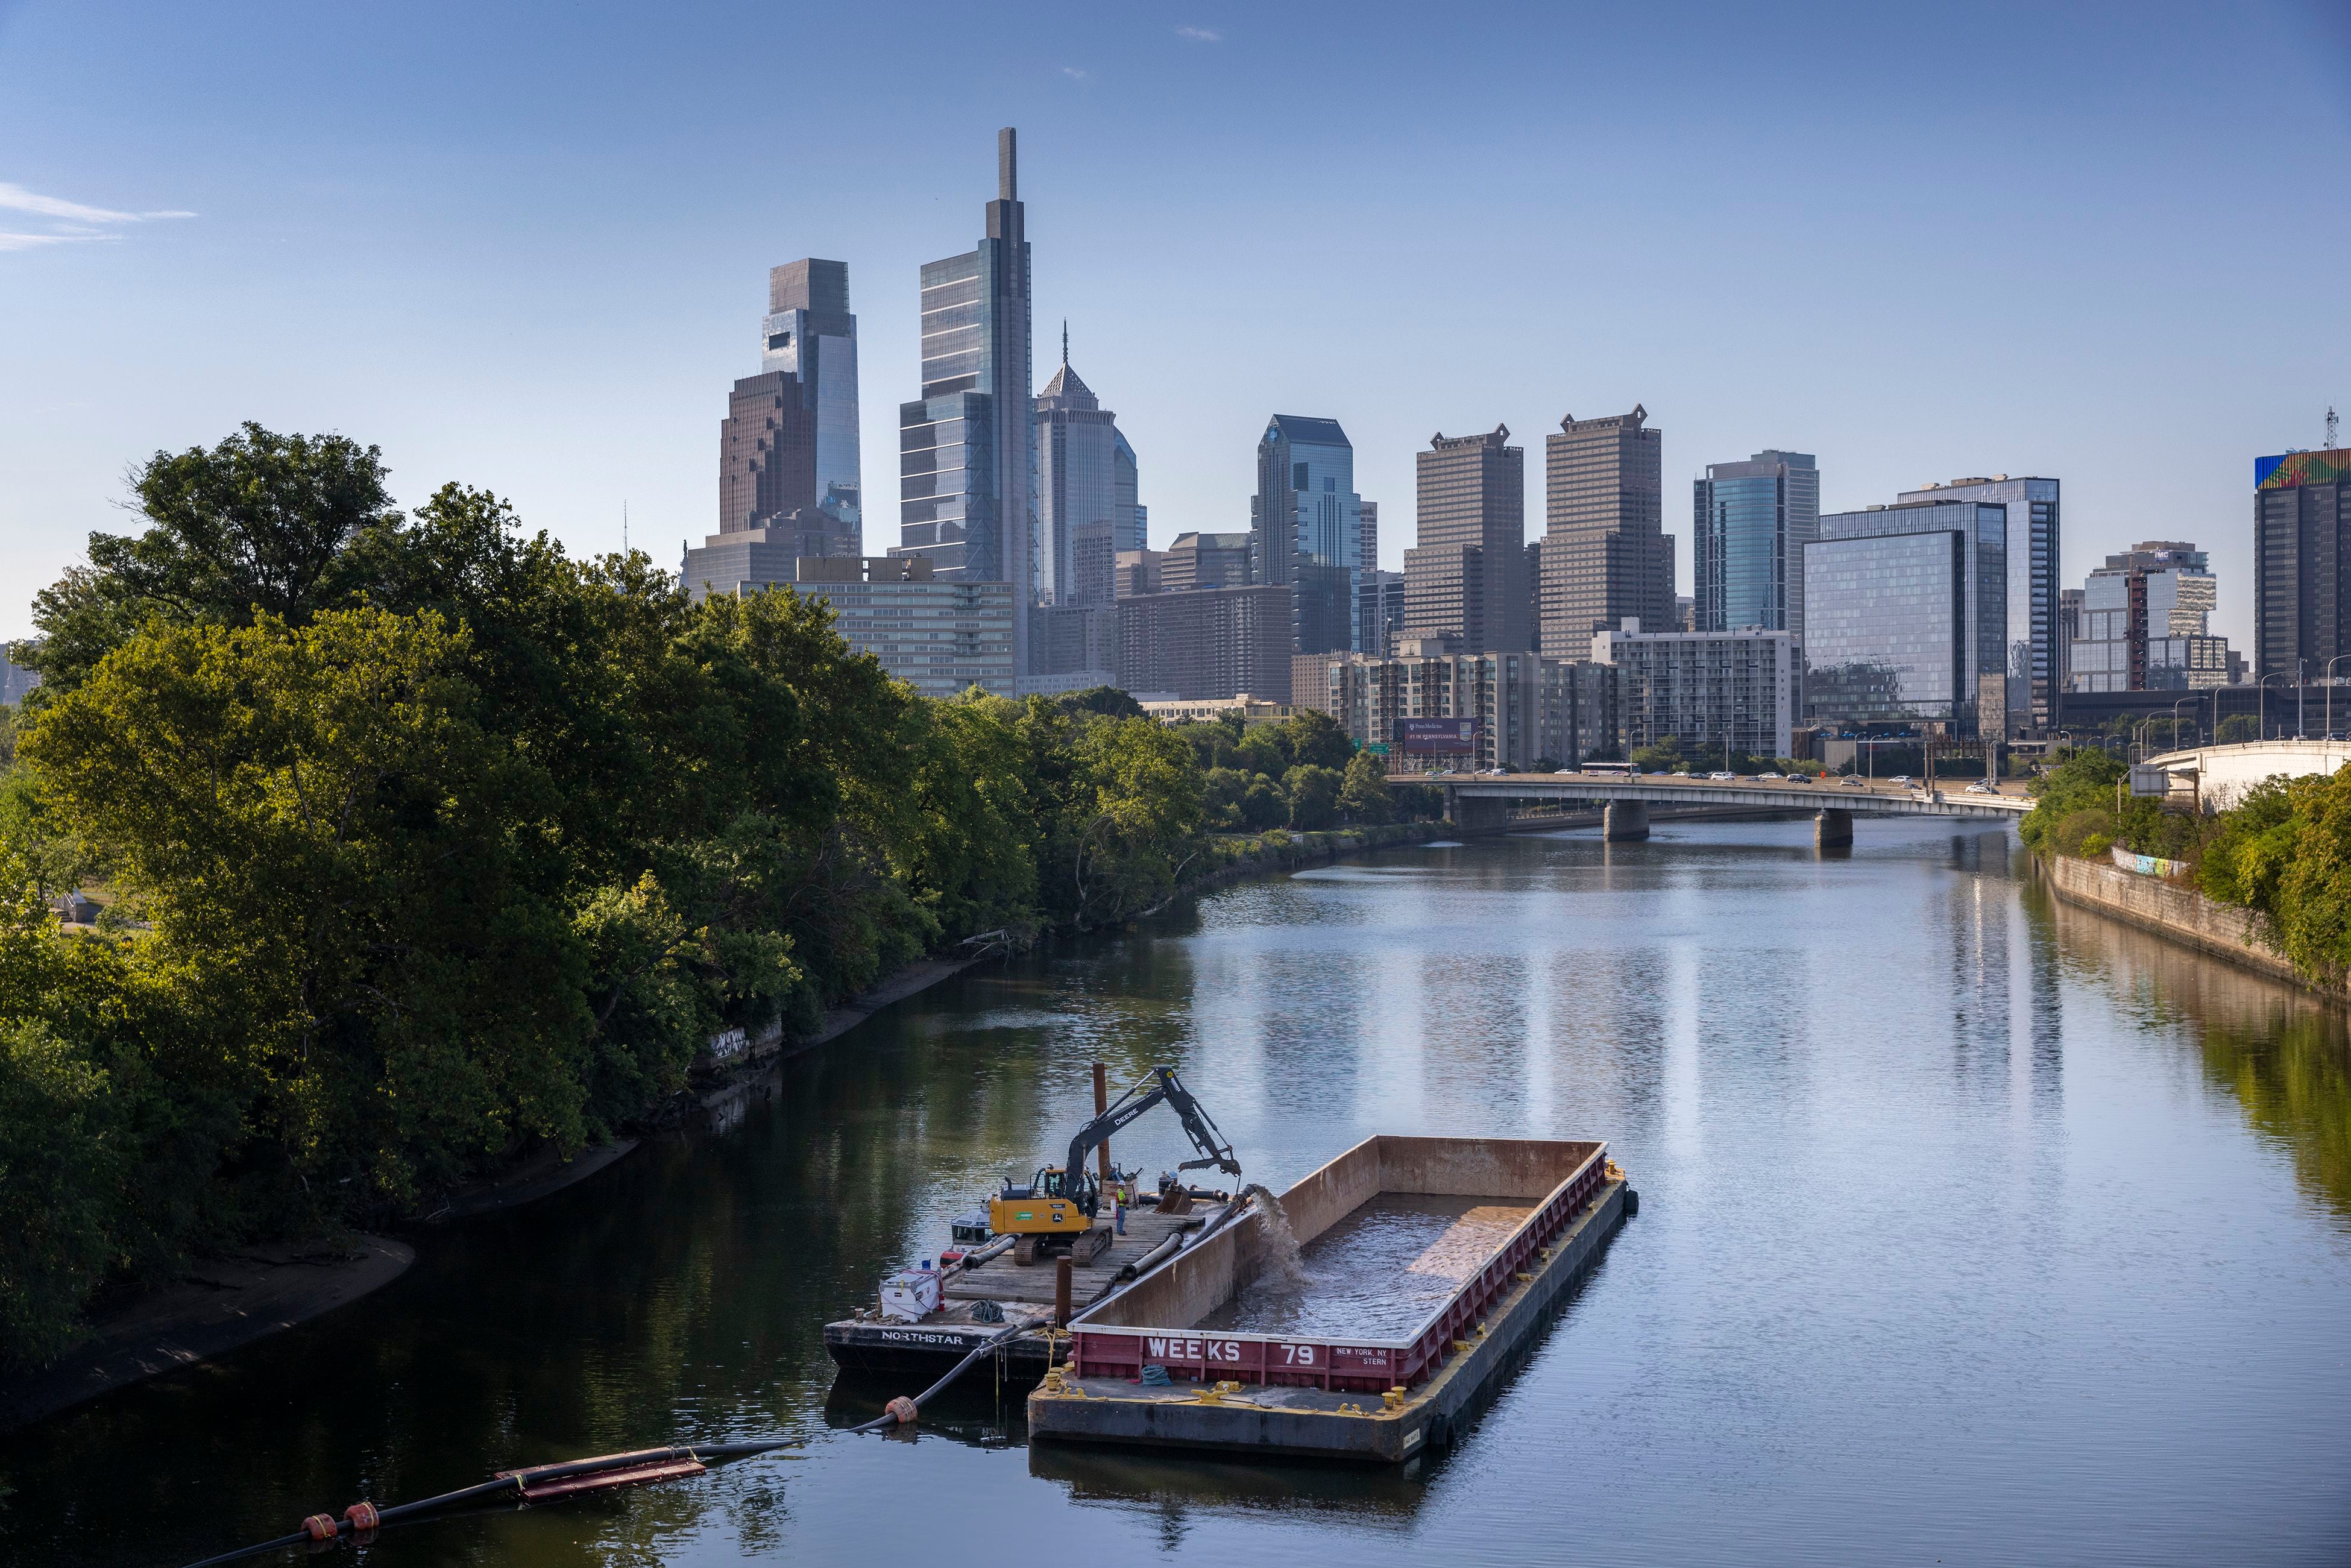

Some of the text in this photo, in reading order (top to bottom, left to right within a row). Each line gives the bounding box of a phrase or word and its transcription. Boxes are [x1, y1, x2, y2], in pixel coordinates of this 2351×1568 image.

[1361, 507, 1374, 515] ank
[1114, 1108, 1139, 1126] DEERE
[882, 1331, 963, 1344] NORTHSTAR
[1148, 1337, 1314, 1365] WEEKS 79
